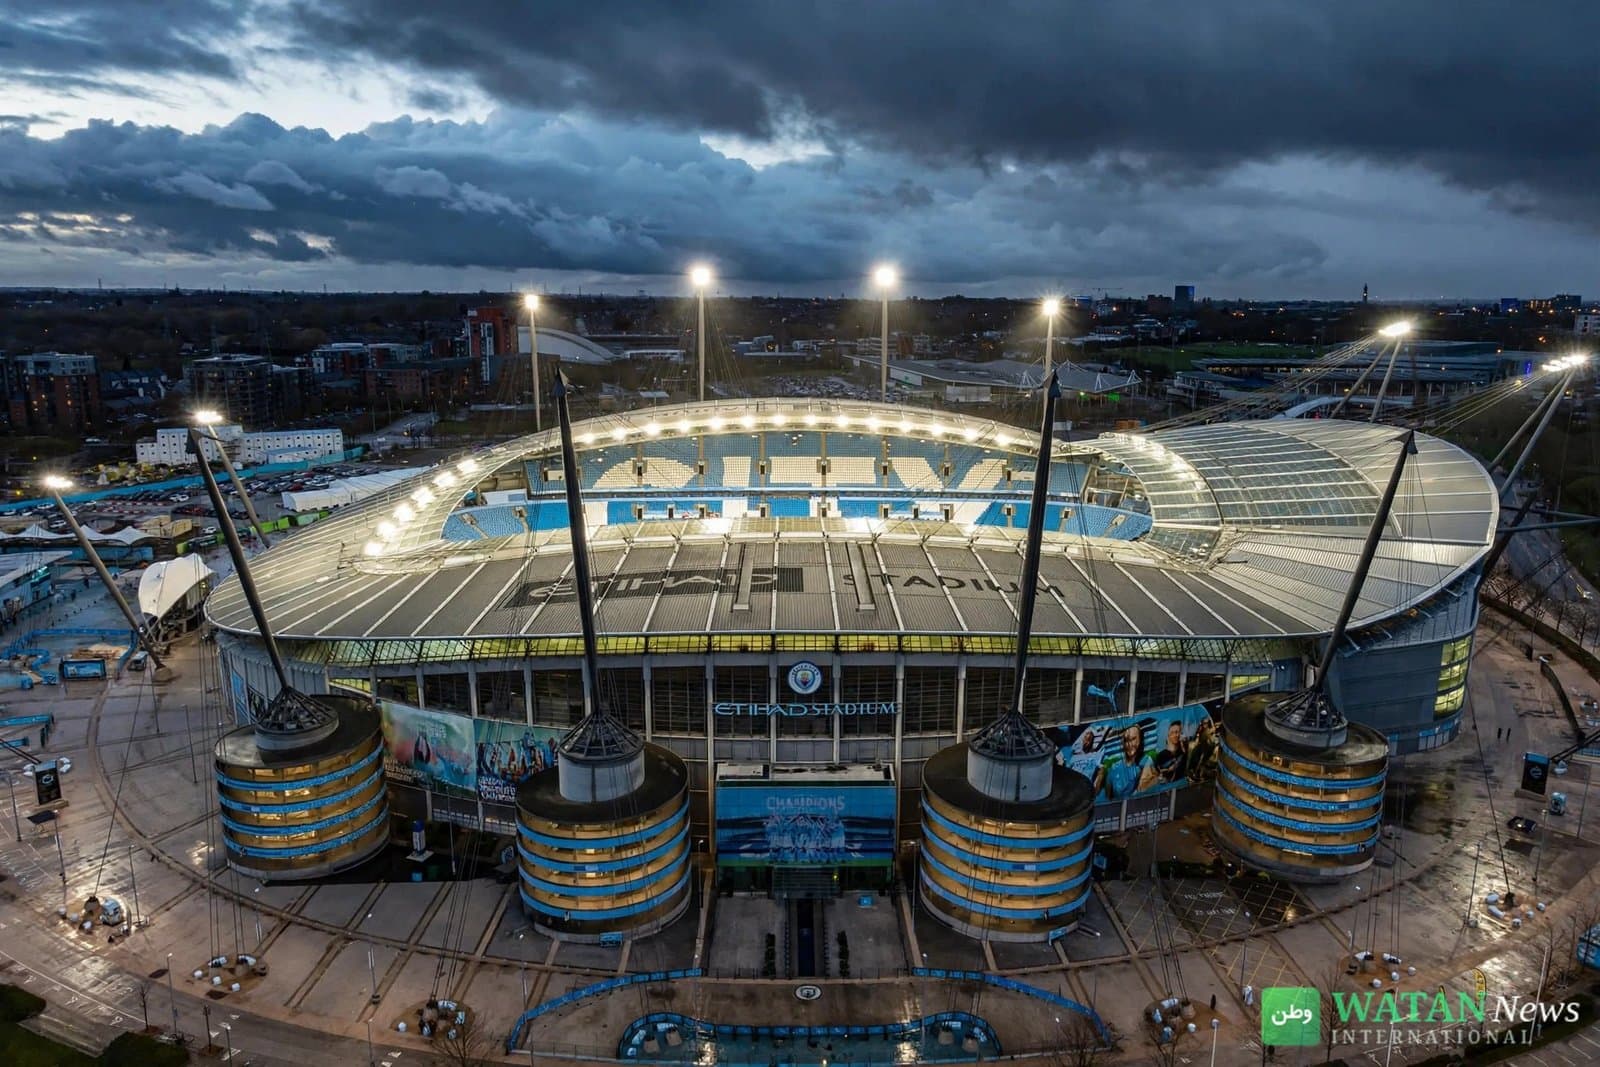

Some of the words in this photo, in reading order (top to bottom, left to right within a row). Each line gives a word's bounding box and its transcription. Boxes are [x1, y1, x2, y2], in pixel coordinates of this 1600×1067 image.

[715, 702, 807, 716] ETIHAD
[810, 702, 897, 715] STADIUM
[767, 796, 845, 811] CHAMPIONS
